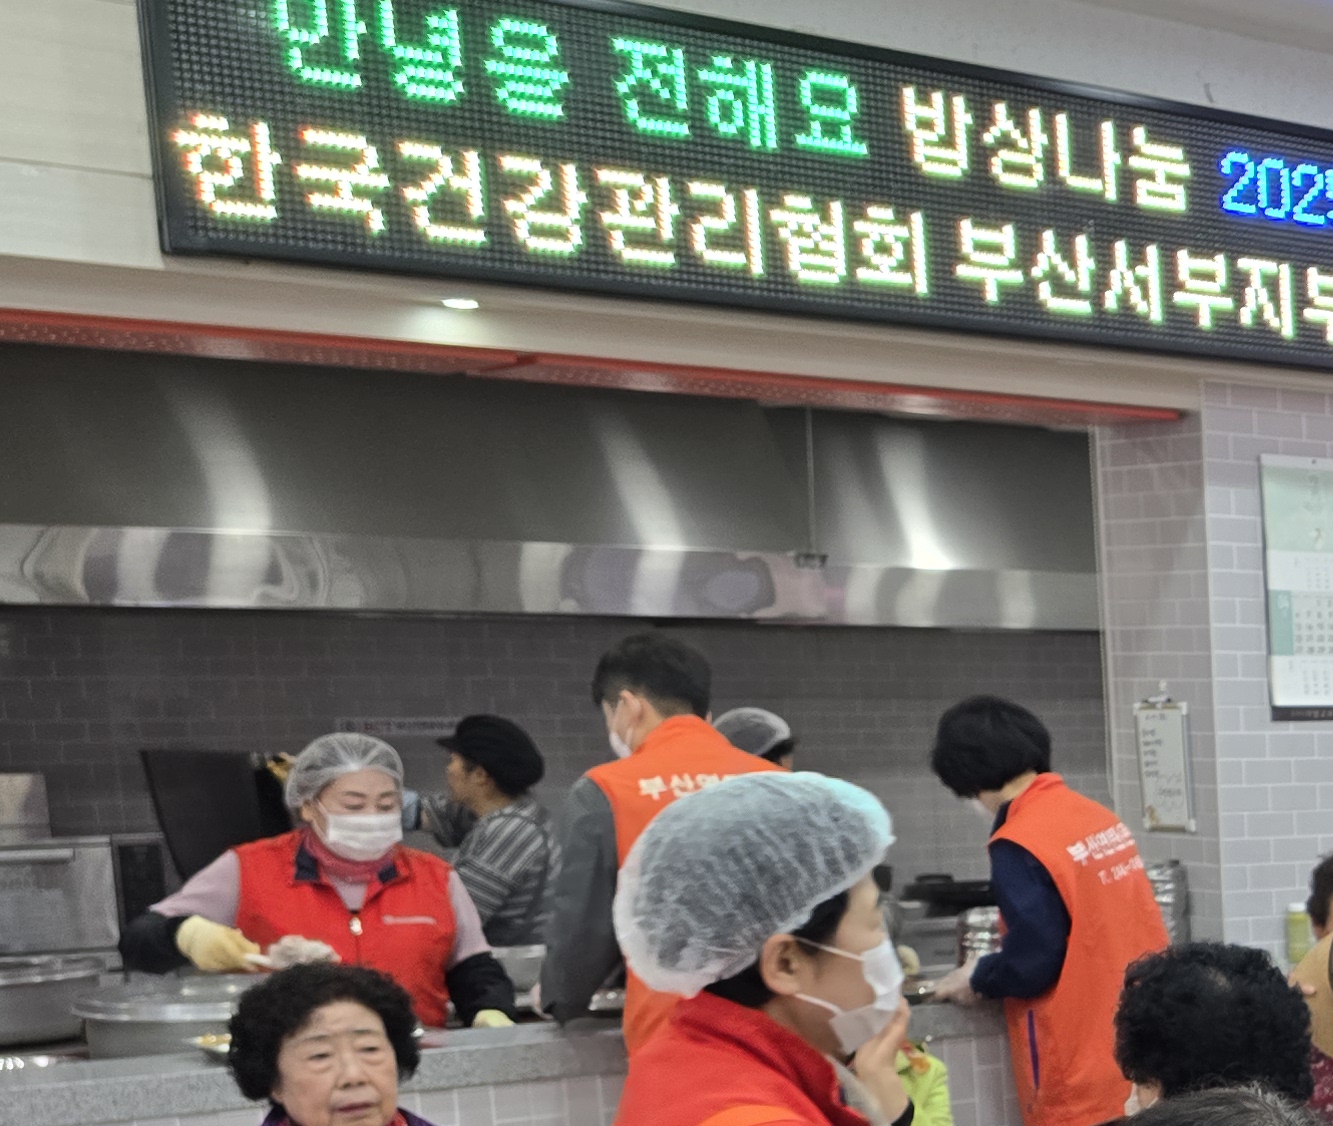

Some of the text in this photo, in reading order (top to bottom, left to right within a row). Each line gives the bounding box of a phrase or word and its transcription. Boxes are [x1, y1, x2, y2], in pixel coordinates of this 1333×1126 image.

[172, 111, 931, 297] 한국건강관리협회
[612, 35, 869, 156] 전해요
[901, 85, 1192, 212] 밥상나눔
